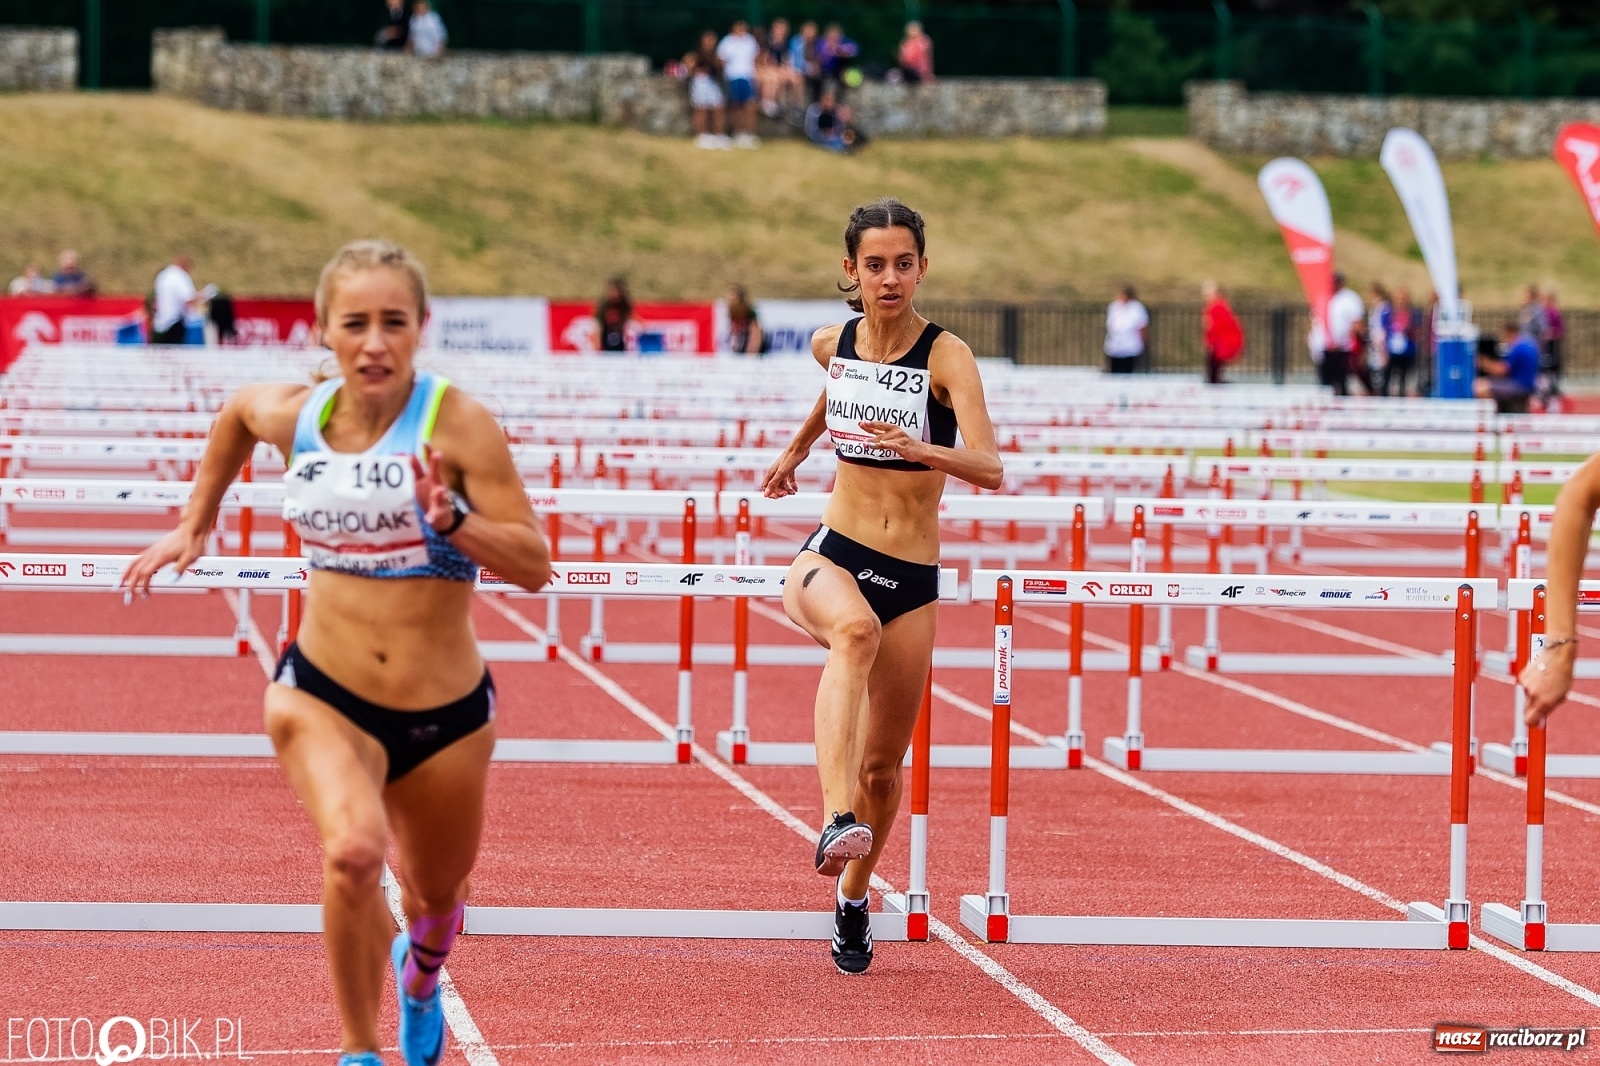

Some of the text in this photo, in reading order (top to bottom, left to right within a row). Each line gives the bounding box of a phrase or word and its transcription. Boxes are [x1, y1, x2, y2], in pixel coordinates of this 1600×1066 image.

[878, 369, 924, 394] 423
[828, 399, 918, 429] MALINOWSKA
[836, 442, 902, 458] CIBÓRZ 201
[296, 461, 404, 488] 4F 140
[24, 565, 64, 575] ORLEN
[237, 571, 271, 579] 4MOVE
[569, 573, 609, 583] ORLEN
[680, 573, 704, 586] 4F
[870, 574, 899, 589] asics
[1111, 585, 1150, 595] ORLEN
[1221, 586, 1245, 598] 4F
[998, 646, 1008, 690] polanik
